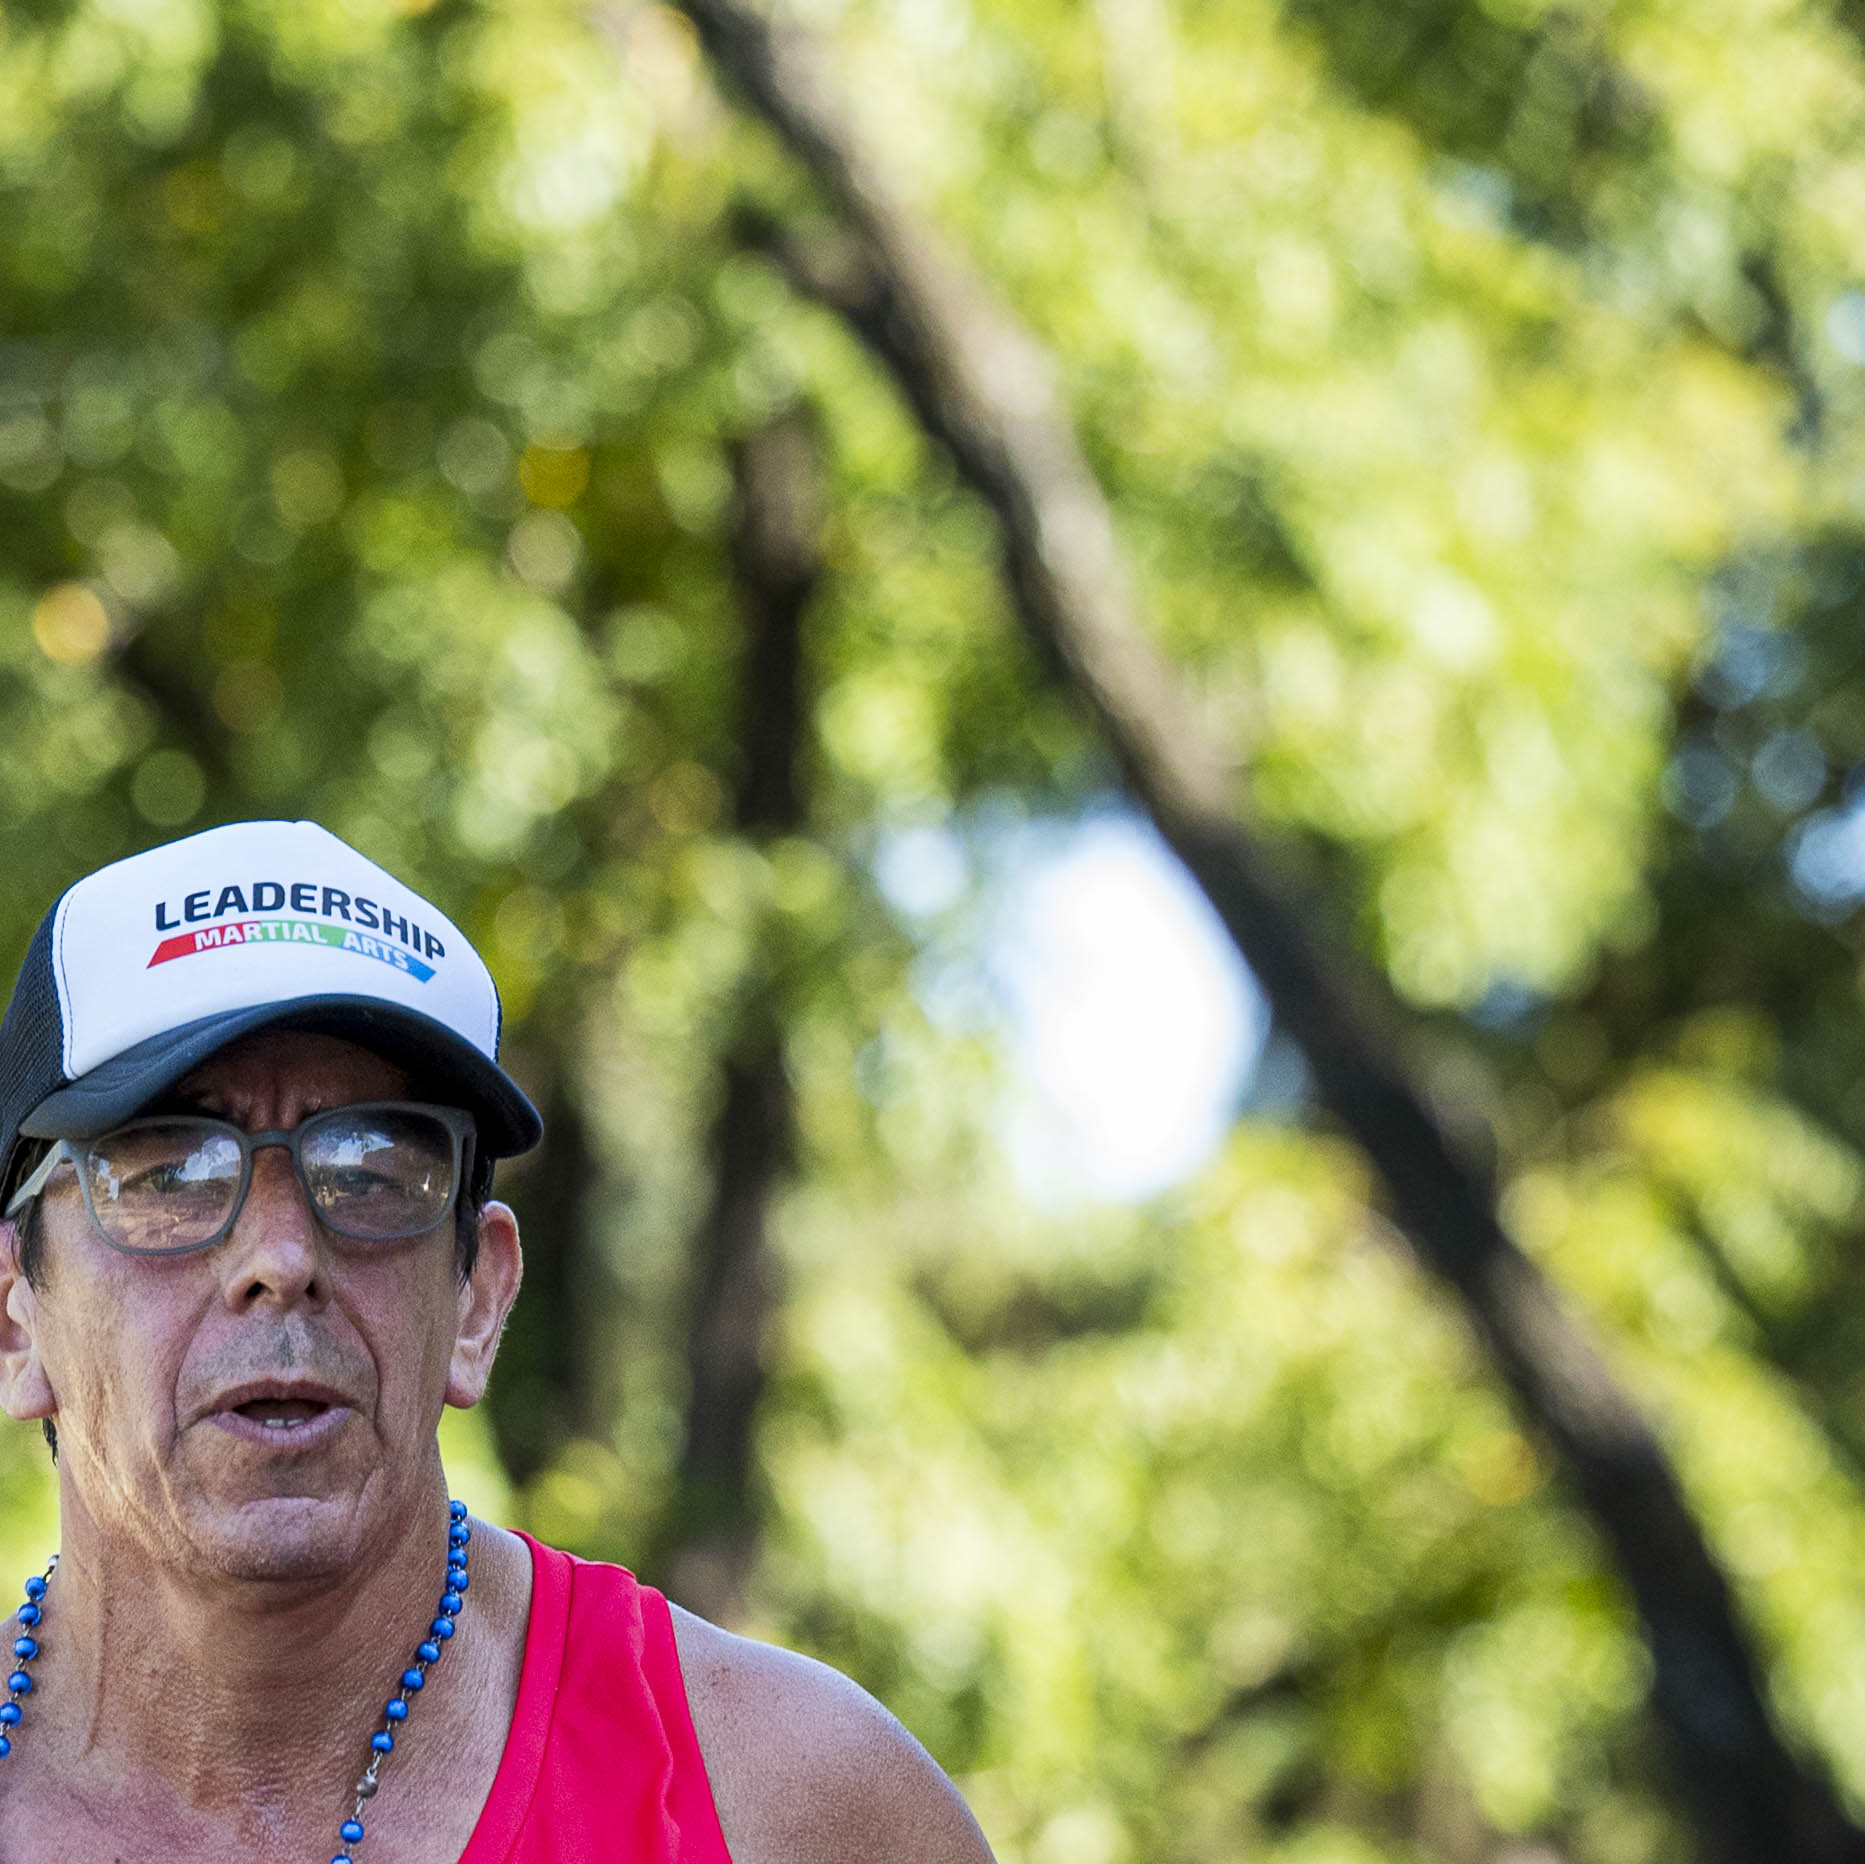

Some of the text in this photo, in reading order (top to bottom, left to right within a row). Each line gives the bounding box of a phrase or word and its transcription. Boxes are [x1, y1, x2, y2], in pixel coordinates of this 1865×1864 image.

[155, 881, 445, 960] LEADERSHIP
[194, 920, 409, 970] MARTIAL ARTS
